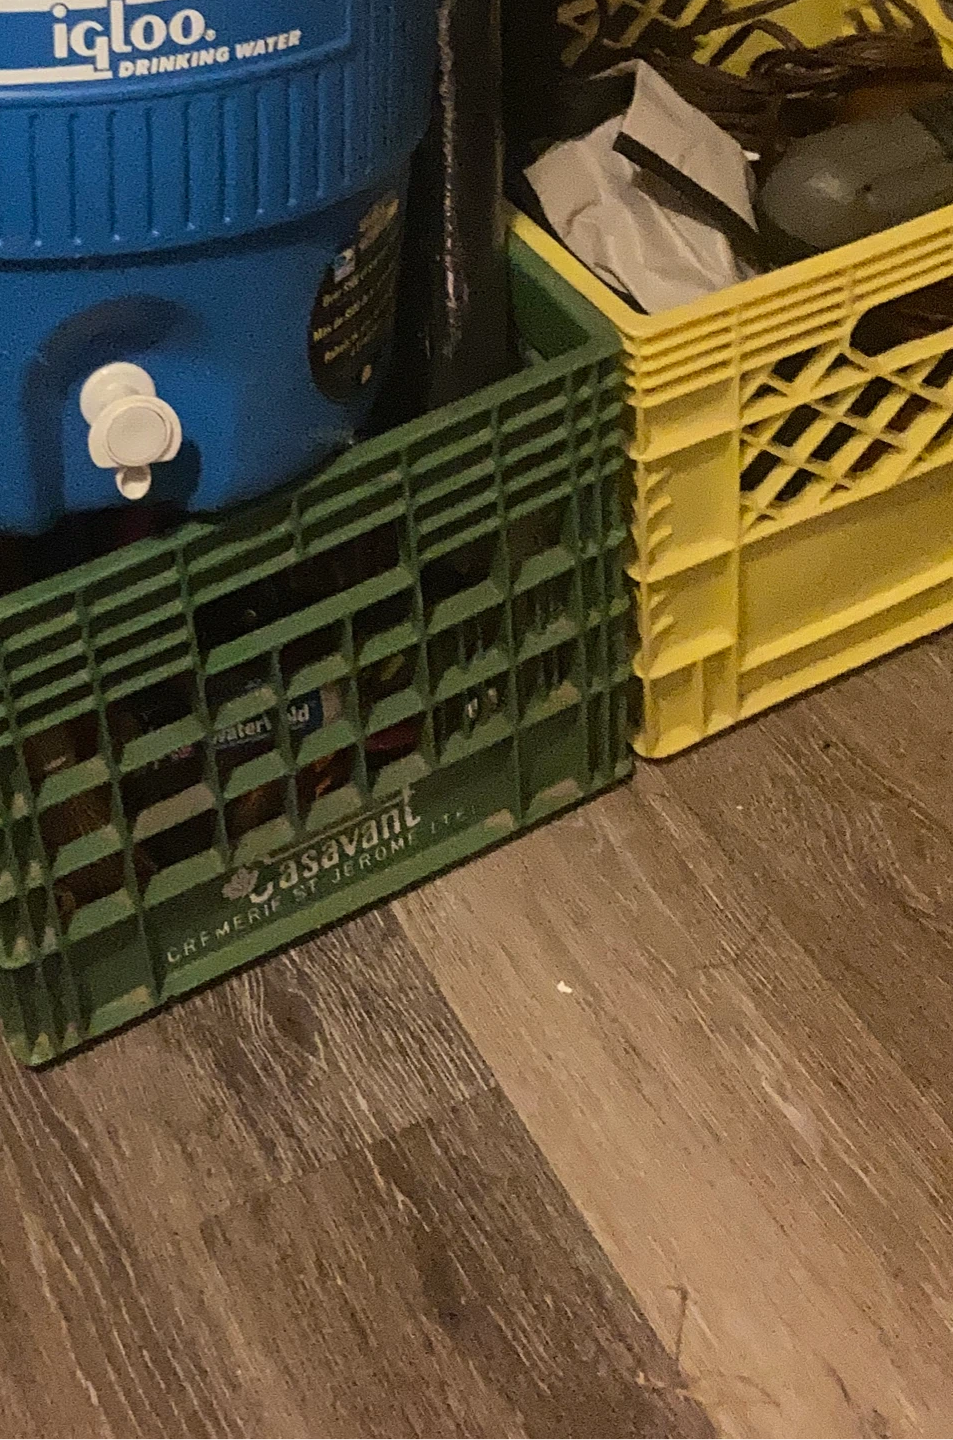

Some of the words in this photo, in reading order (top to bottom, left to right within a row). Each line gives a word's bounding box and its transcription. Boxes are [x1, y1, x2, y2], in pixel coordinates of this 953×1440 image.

[119, 47, 230, 78] DRINKING
[235, 29, 302, 59] WATER
[249, 786, 421, 904] Casavant
